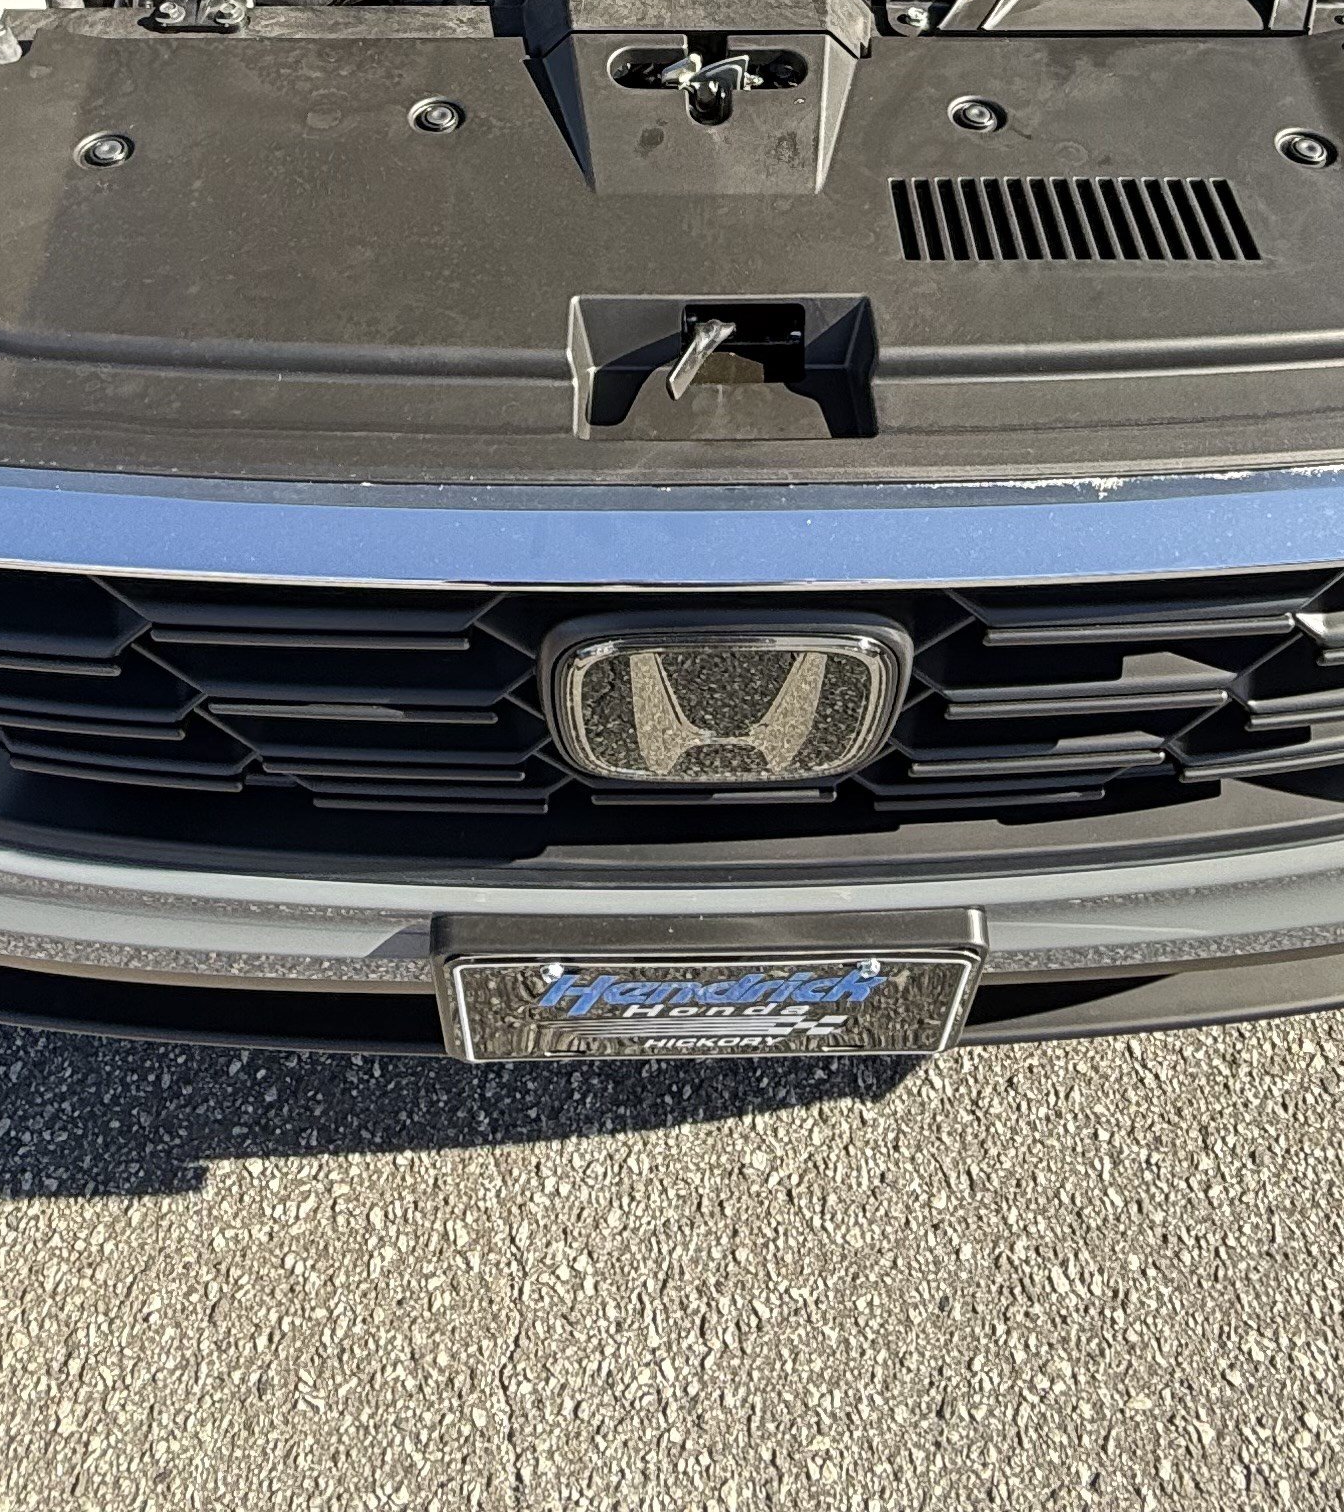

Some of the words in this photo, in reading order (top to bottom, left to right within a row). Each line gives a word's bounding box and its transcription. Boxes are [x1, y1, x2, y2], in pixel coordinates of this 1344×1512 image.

[539, 969, 887, 1017] Hendrick
[622, 1002, 810, 1018] Honda
[644, 1036, 786, 1048] HICKORY
